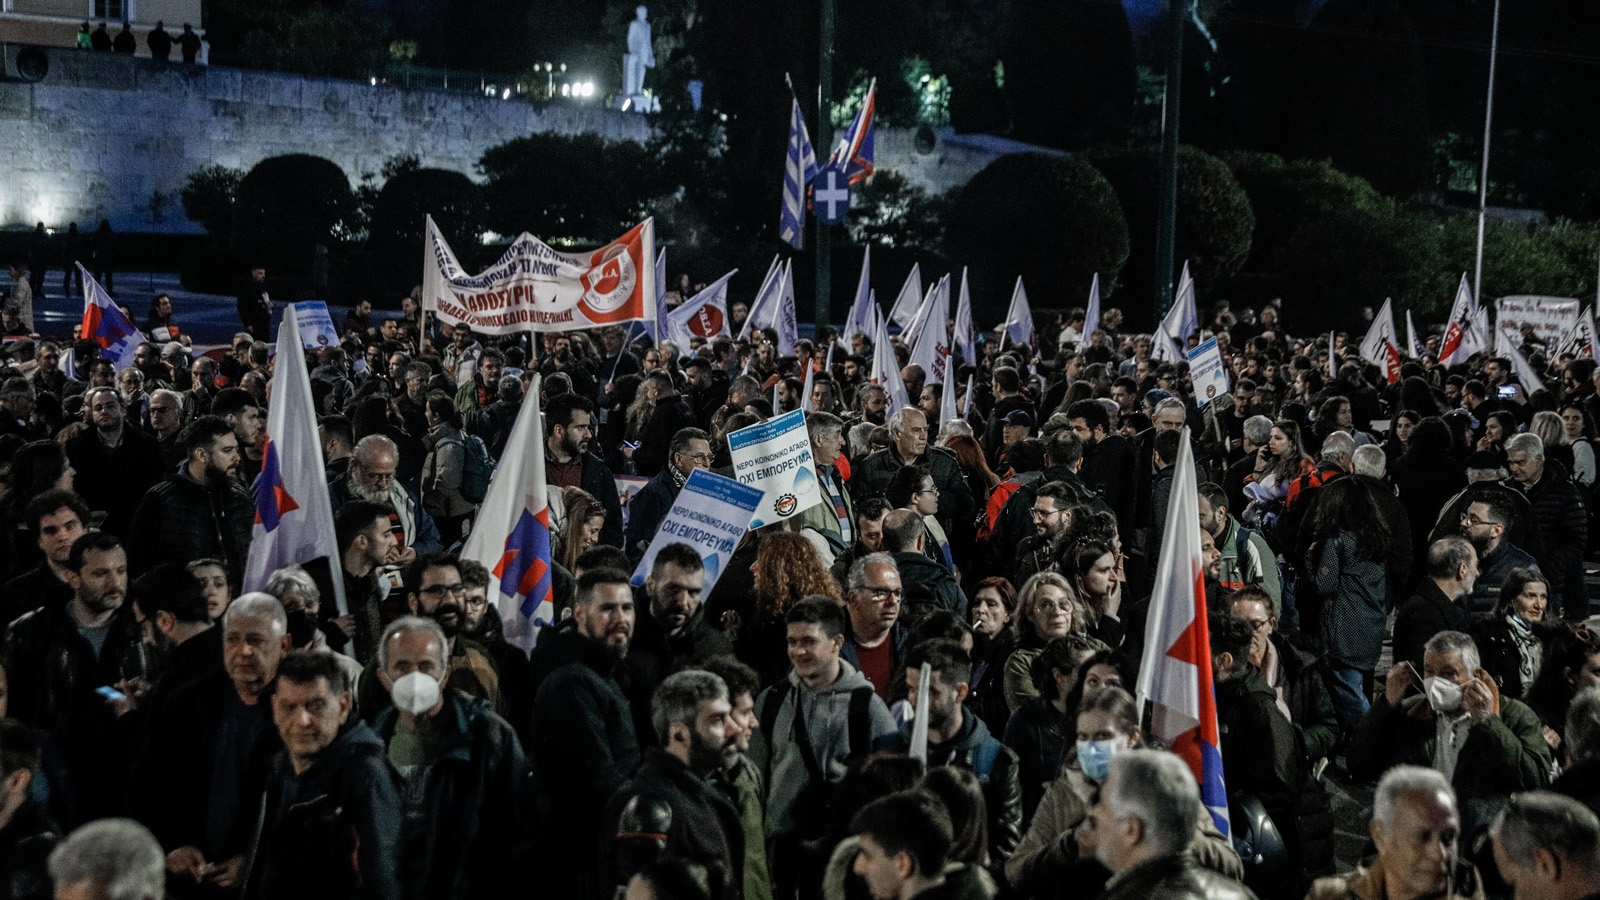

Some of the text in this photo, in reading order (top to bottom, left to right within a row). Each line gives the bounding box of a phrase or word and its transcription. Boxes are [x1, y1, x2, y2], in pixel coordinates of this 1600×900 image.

[736, 439, 809, 471] ΝΕΡΟ ΚΟΙΝΩΝΙΚΟ ΑΓΑΘΟ
[739, 452, 812, 485] ΟΧΙ ΕΜΠΟΡΕΥΜΑ
[672, 505, 744, 536] ΝΕΡΟ ΚΟΙΝΩΝΙΚΟ ΑΓΑΘΟ
[662, 520, 735, 555] ΟΧΙ ΕΜΠΟΡΕΥΜΑ
